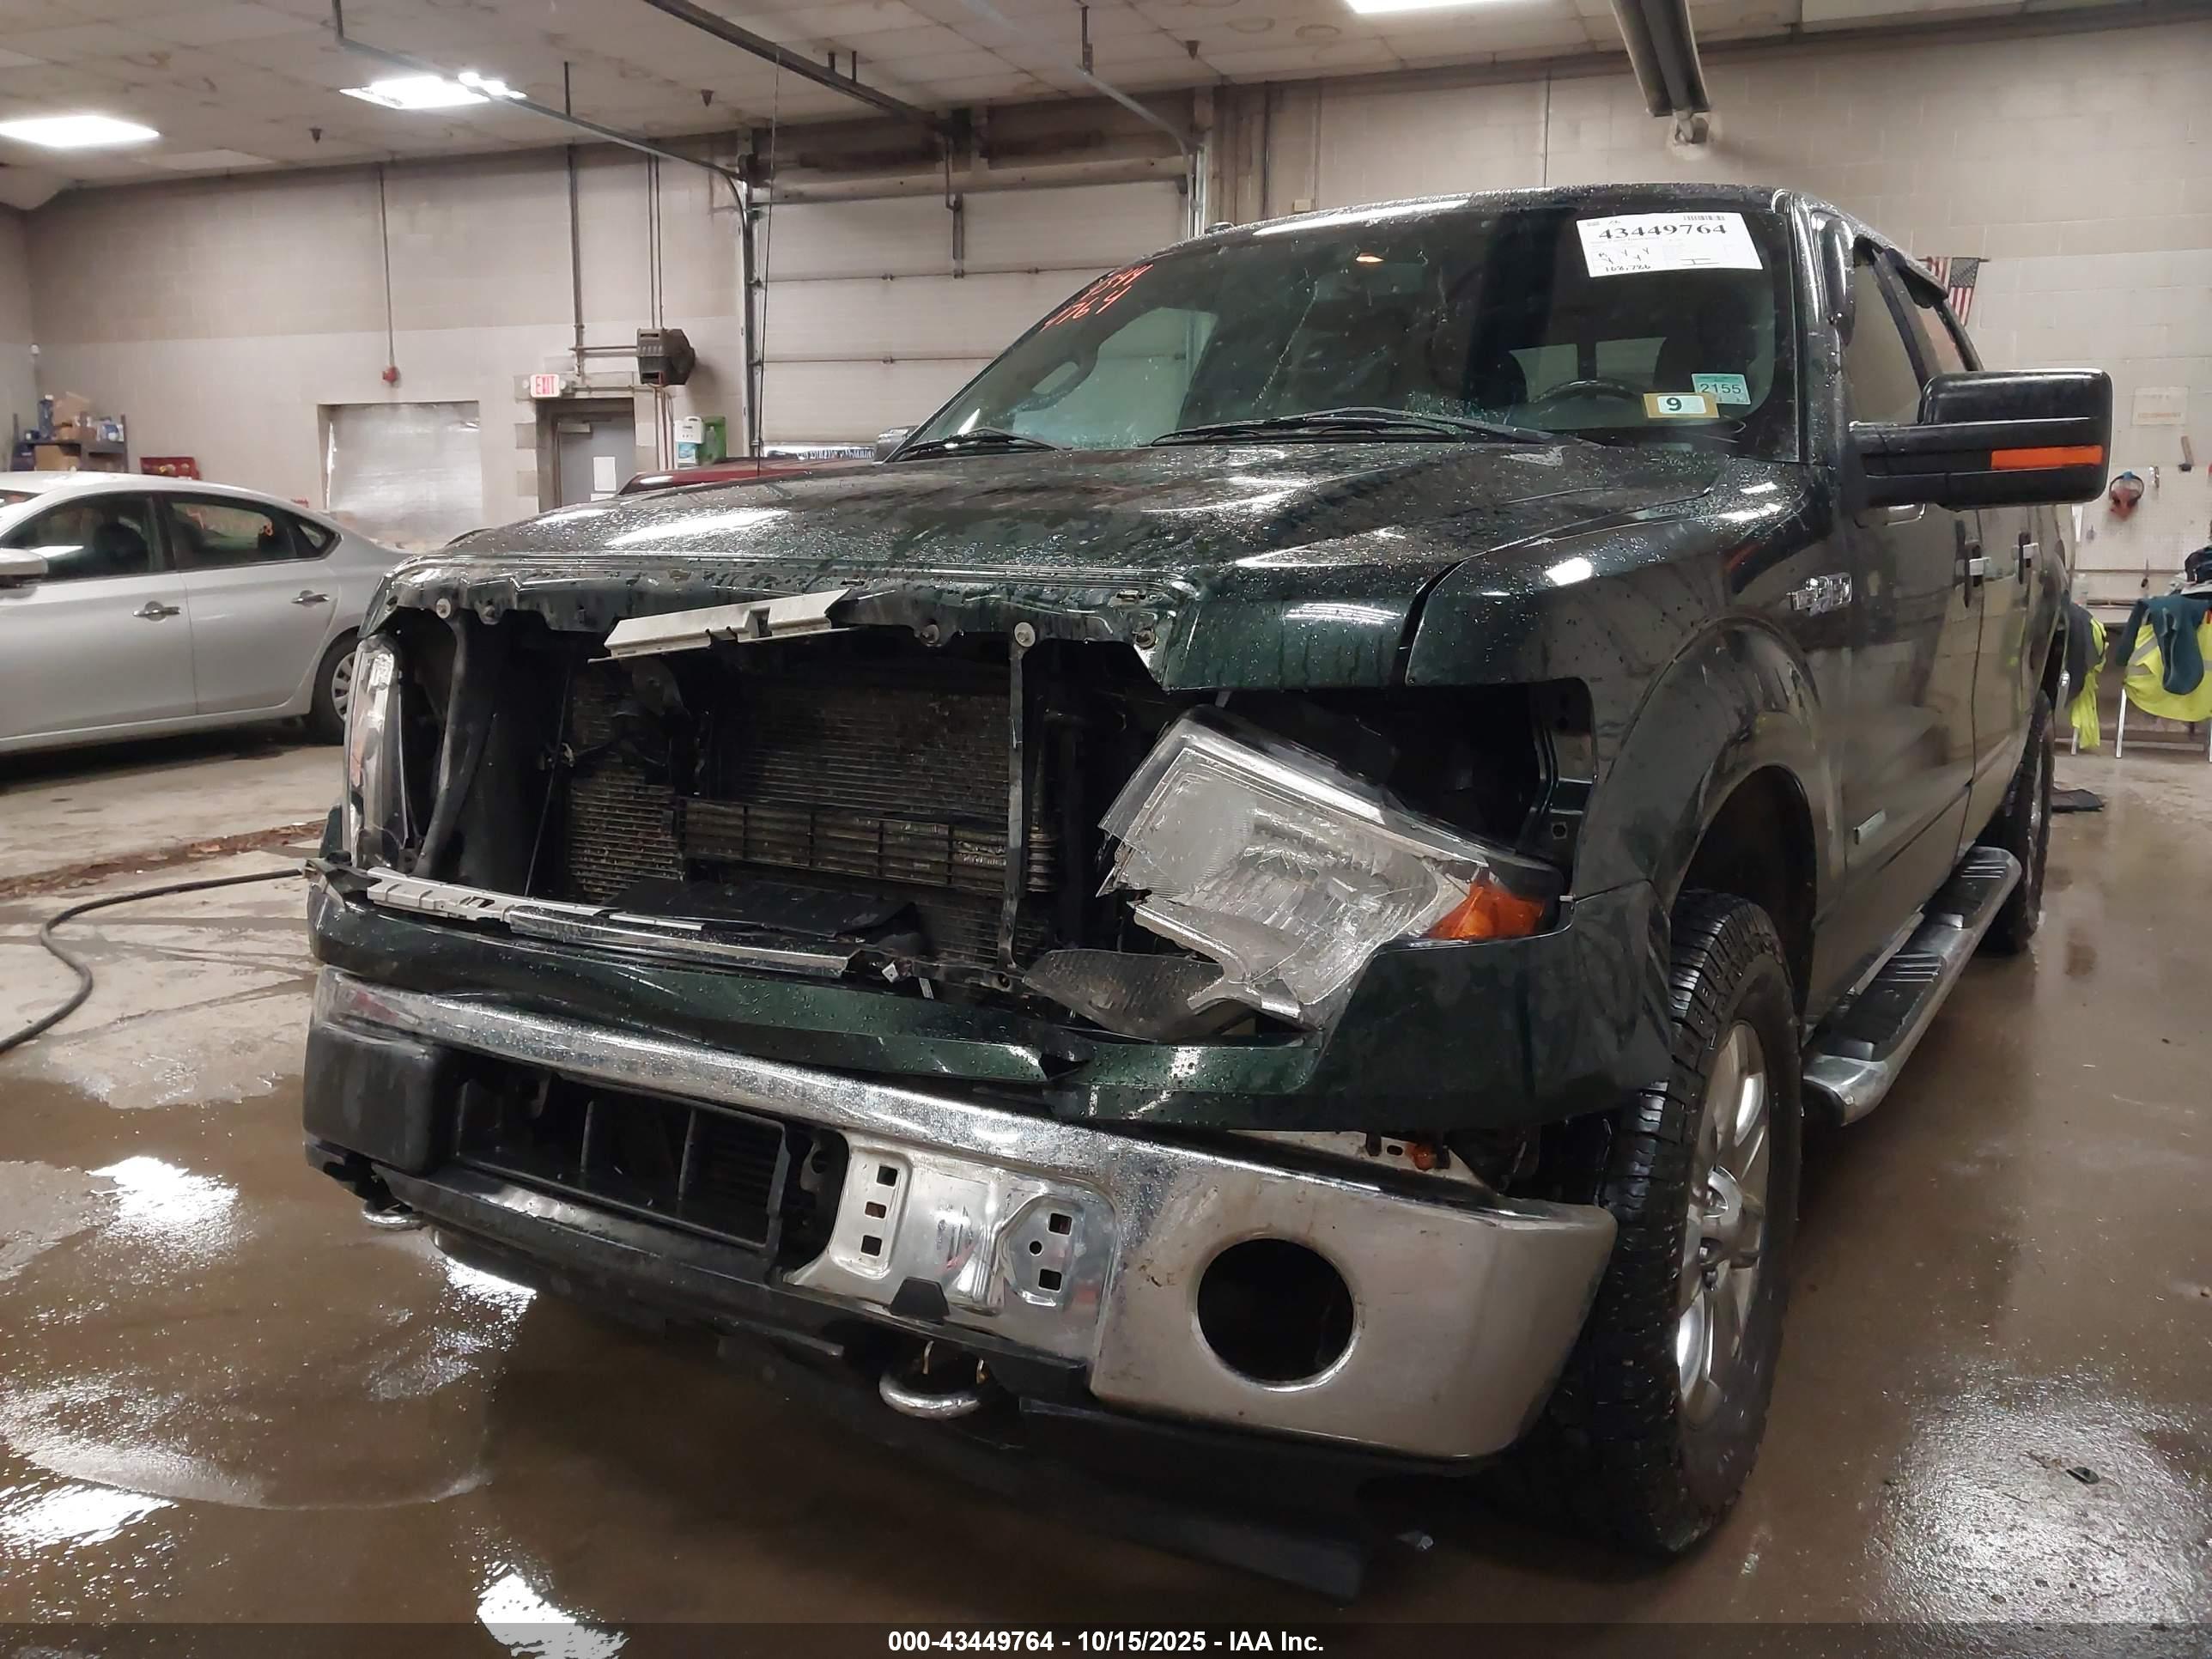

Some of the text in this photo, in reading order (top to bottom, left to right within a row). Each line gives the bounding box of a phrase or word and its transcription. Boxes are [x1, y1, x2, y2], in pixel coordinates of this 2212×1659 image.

[1598, 224, 1728, 240] 43449764
[535, 375, 556, 395] EXIT
[1699, 383, 1742, 394] 2155
[1666, 397, 1682, 411] 9
